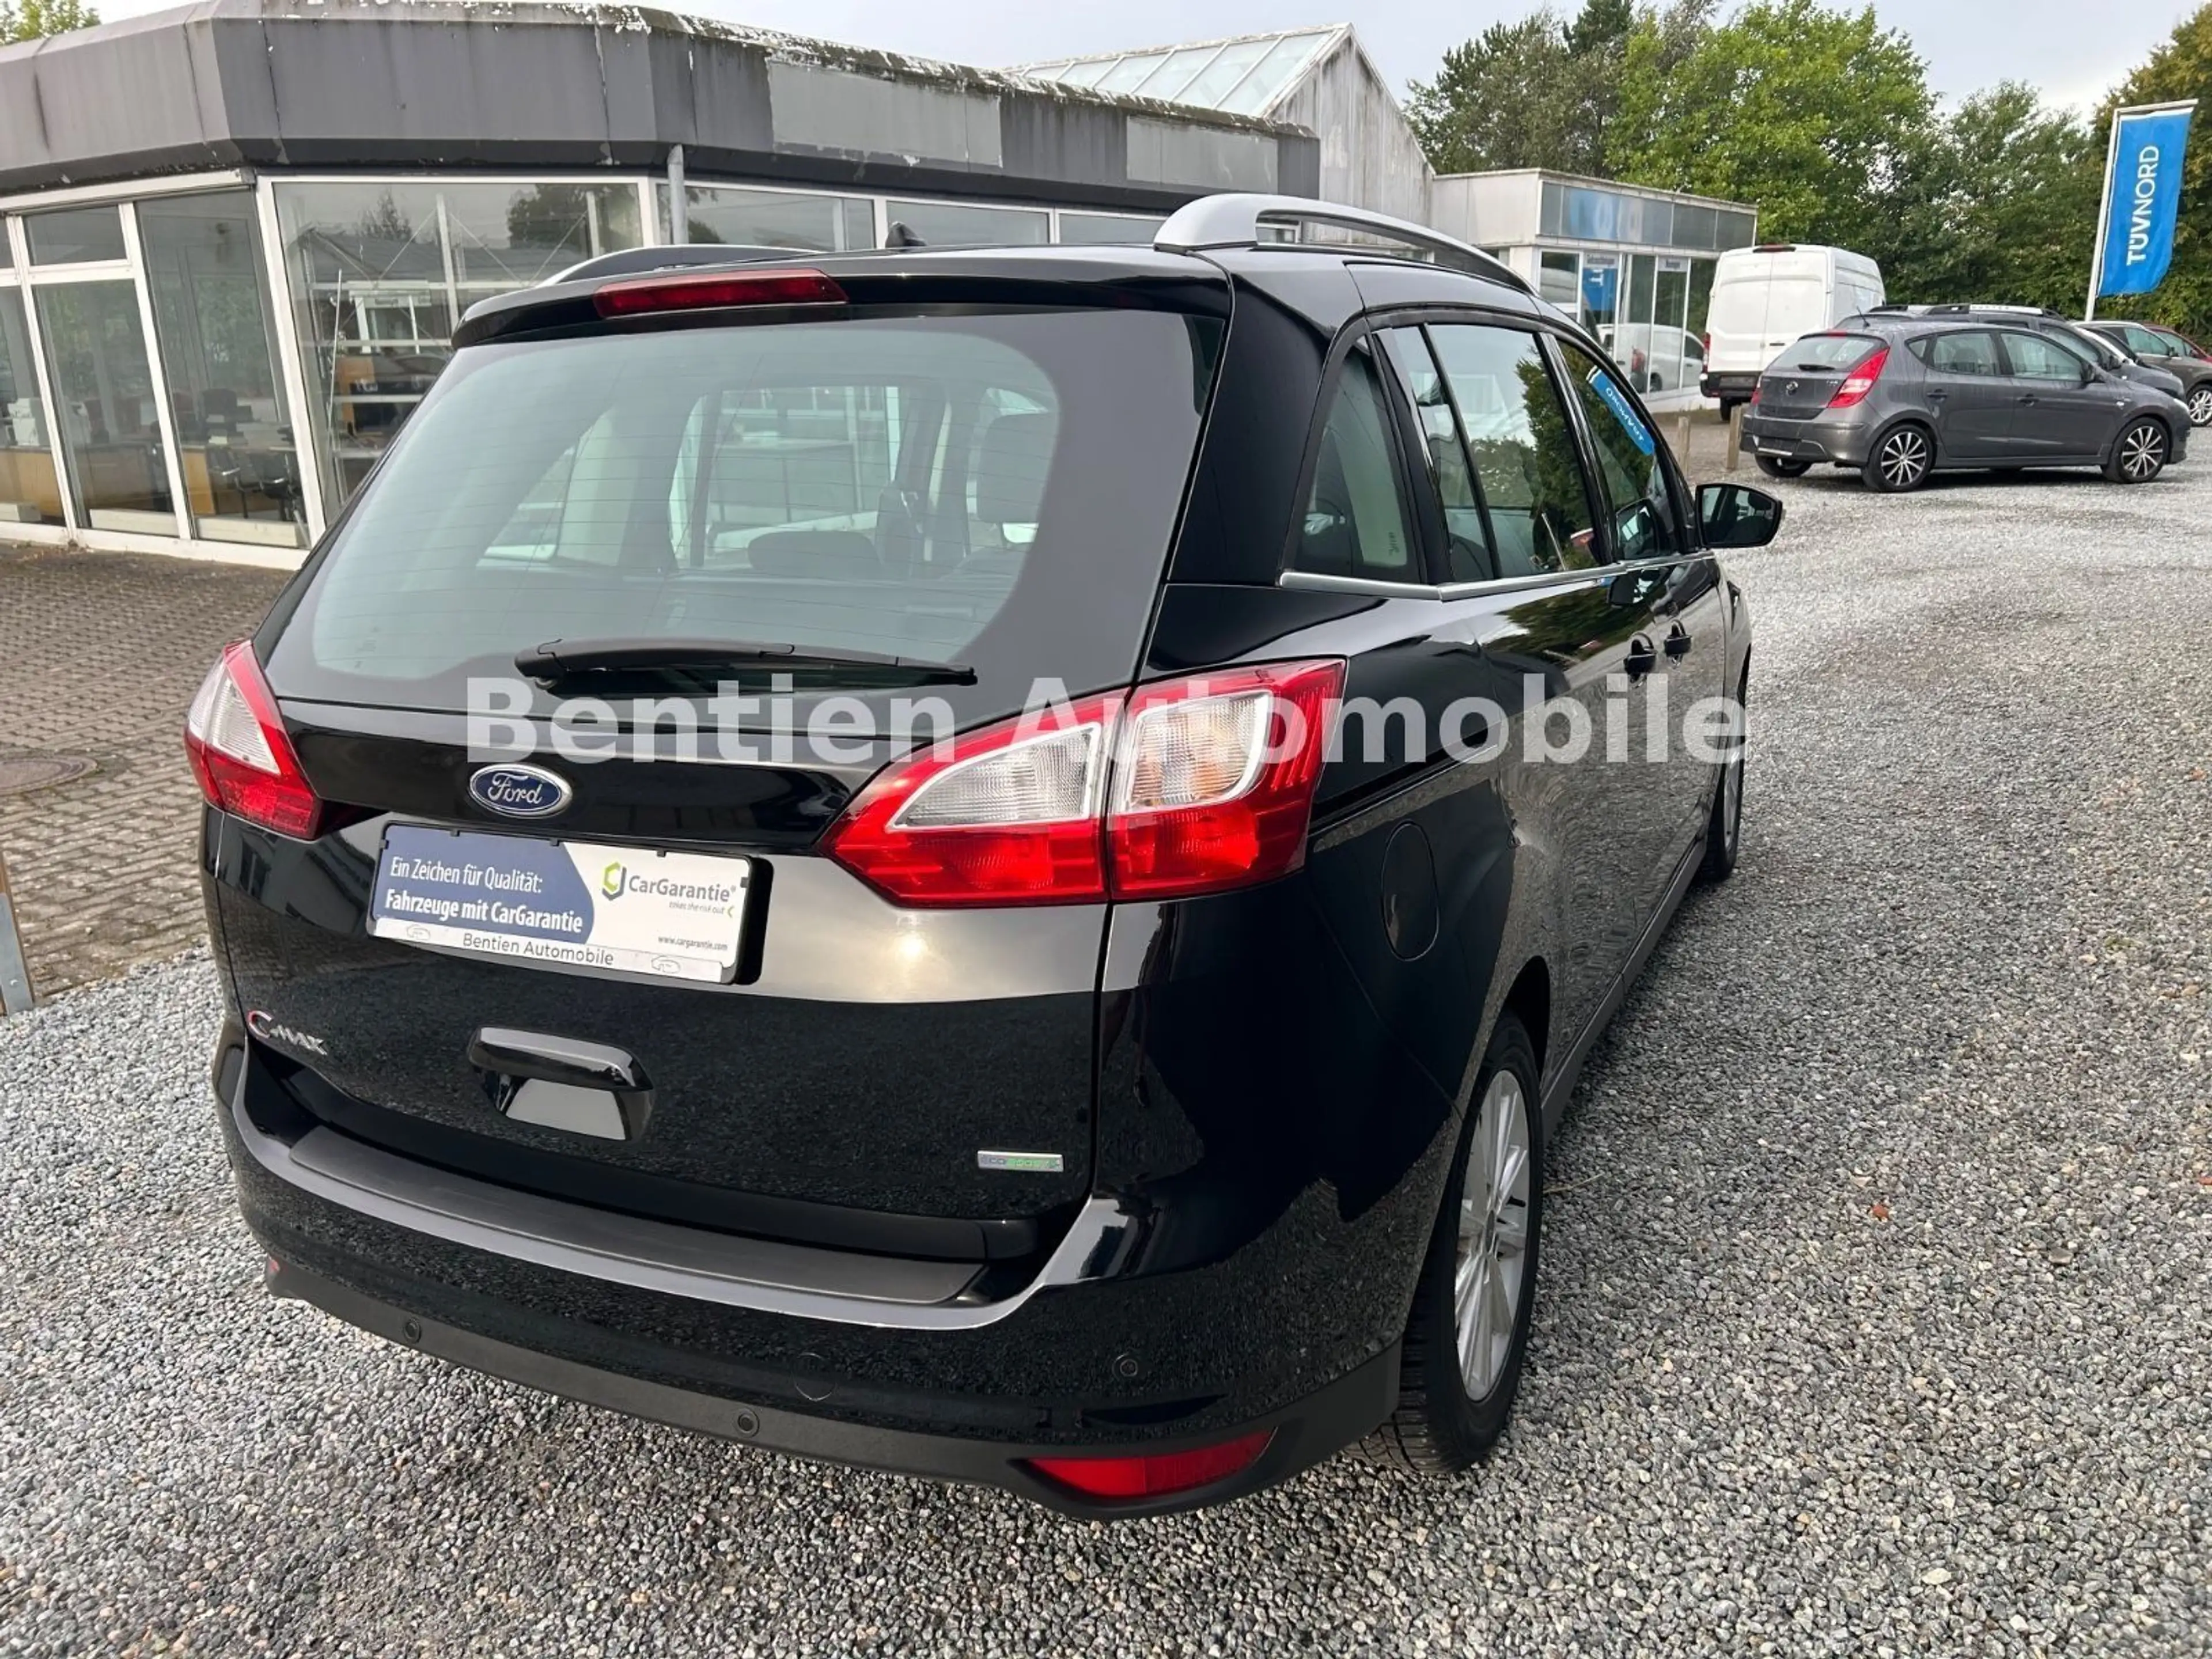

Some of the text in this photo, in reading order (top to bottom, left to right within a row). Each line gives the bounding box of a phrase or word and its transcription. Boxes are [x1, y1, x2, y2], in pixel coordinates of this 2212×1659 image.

[488, 772, 543, 804] Ford
[390, 856, 543, 893] Ein Zeichen für Qualität:
[385, 888, 583, 933] Fahrzeuge mit CarGarantie
[463, 933, 614, 965] Bentien Automobile
[658, 936, 728, 951] www.cargarantie.com
